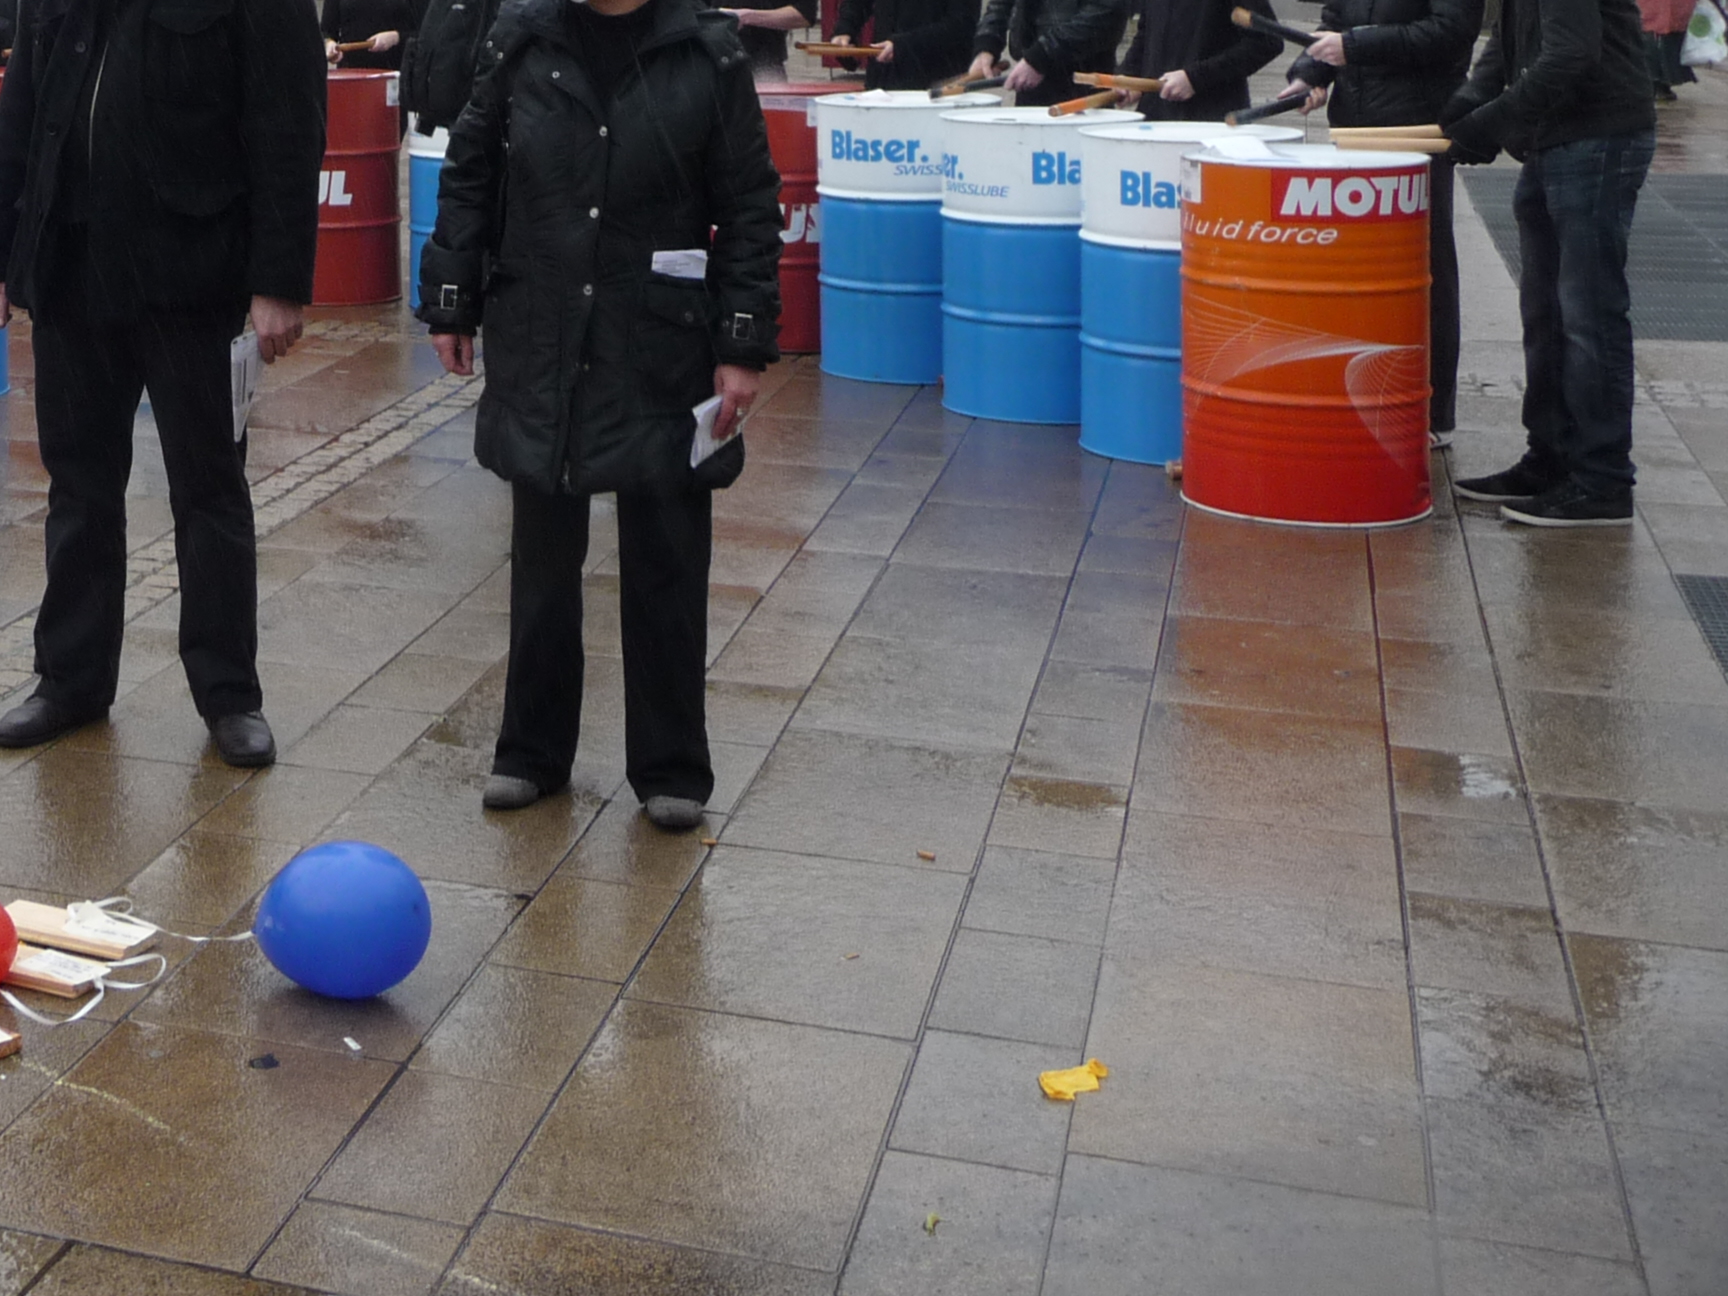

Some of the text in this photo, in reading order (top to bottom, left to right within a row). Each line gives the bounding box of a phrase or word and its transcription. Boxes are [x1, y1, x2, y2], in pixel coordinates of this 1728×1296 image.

[831, 129, 929, 163] Blaser.
[946, 180, 1010, 198] SWISSLUBE
[1120, 170, 1183, 210] Bla
[1279, 173, 1429, 218] MOTUL
